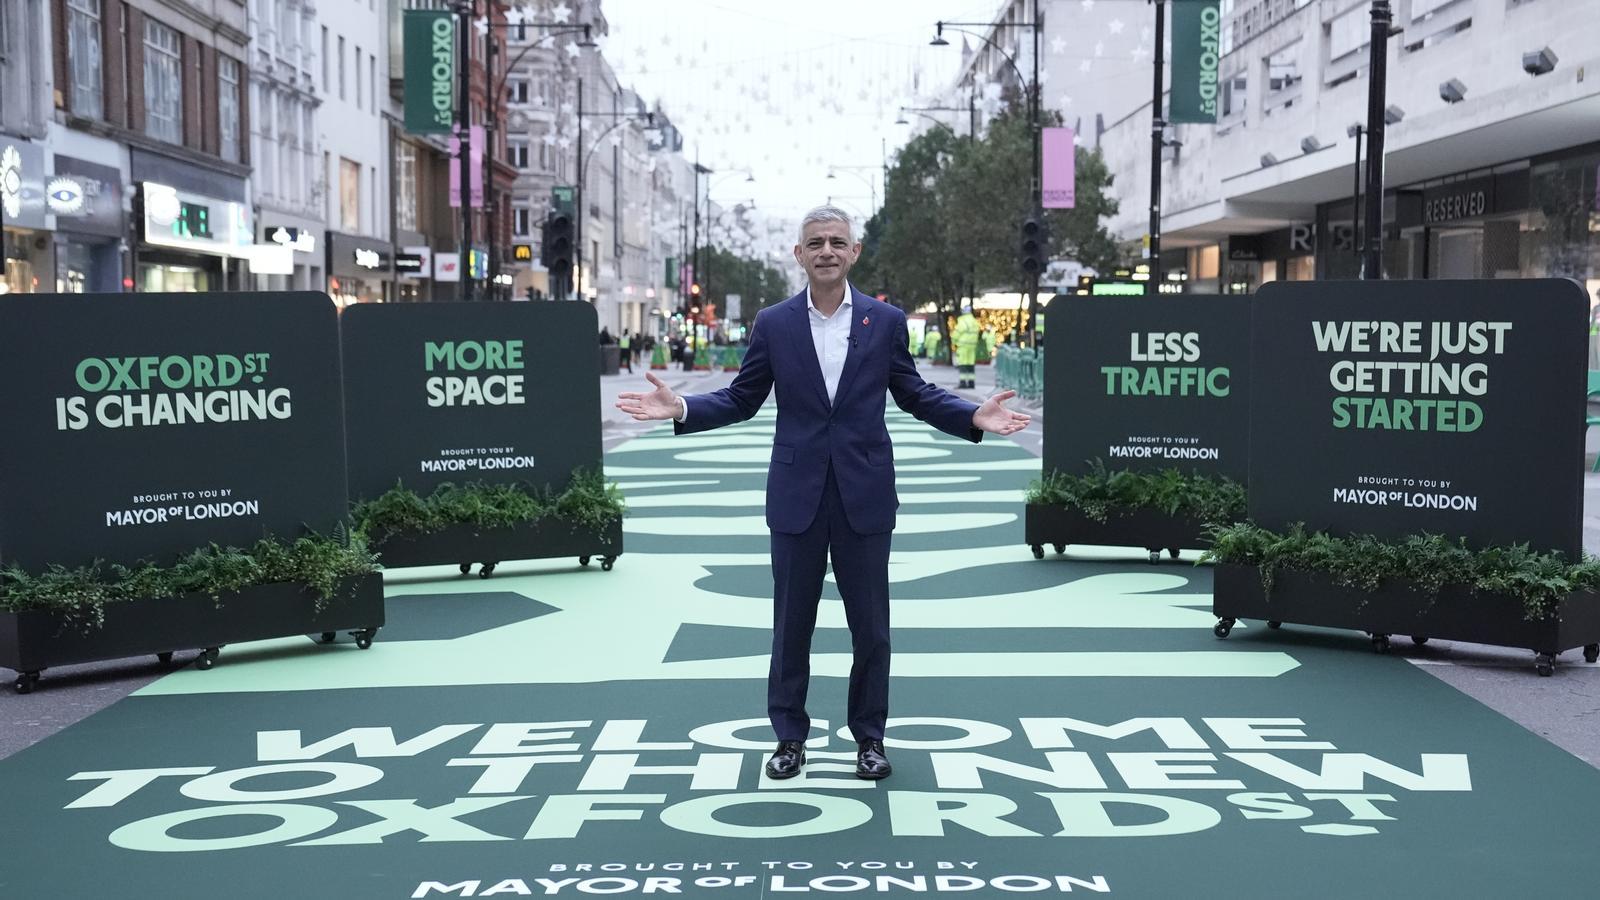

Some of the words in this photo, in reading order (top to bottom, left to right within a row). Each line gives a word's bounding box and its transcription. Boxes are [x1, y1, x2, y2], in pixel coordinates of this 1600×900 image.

[432, 17, 451, 110] OXFORD
[1199, 7, 1219, 100] OXFORD
[1425, 191, 1485, 222] RESERVED
[425, 340, 524, 371] MORE
[1131, 332, 1200, 362] LESS
[1430, 321, 1512, 361] JUST
[76, 355, 243, 392] OXFORD
[244, 353, 269, 383] ST
[1101, 367, 1229, 397] TRAFFIC
[1330, 361, 1487, 395] GETTING
[426, 375, 525, 407] SPACE
[56, 396, 88, 430] IS
[96, 388, 291, 428] CHANGING
[1333, 397, 1483, 432] STARTED
[440, 448, 474, 457] BROUGHT
[476, 447, 487, 455] TO
[505, 446, 514, 454] BY
[1109, 445, 1152, 458] MAYOR
[1151, 446, 1164, 455] OF
[1163, 446, 1219, 460] LONDON
[1128, 436, 1160, 444] BROUGHT
[1162, 436, 1172, 444] TO
[1190, 437, 1199, 445] BY
[420, 458, 467, 473] MAYOR
[466, 457, 478, 467] OF
[478, 455, 535, 470] LONDON
[133, 492, 179, 504] BROUGHT
[181, 491, 195, 500] TO
[198, 489, 218, 499] YOU
[220, 488, 232, 497] BY
[1358, 476, 1399, 486] BROUGHT
[1402, 478, 1415, 487] TO
[1418, 479, 1437, 488] YOU
[1440, 480, 1451, 489] BY
[106, 508, 168, 526] MAYOR
[168, 505, 184, 517] OF
[185, 500, 258, 520] LONDON
[1333, 487, 1388, 506] MAYOR
[1388, 491, 1403, 502] OF
[1405, 492, 1476, 511] LONDON
[257, 717, 1337, 761] WELCOME
[64, 762, 384, 808] TO
[446, 751, 876, 793] THE
[930, 751, 1472, 794] NEW
[108, 791, 1221, 851] OXFORD
[1226, 792, 1397, 836] ST
[550, 862, 739, 871] BROUGHT
[411, 877, 682, 898] MAYOR
[695, 876, 756, 887] OF
[771, 876, 1110, 892] LONDON
